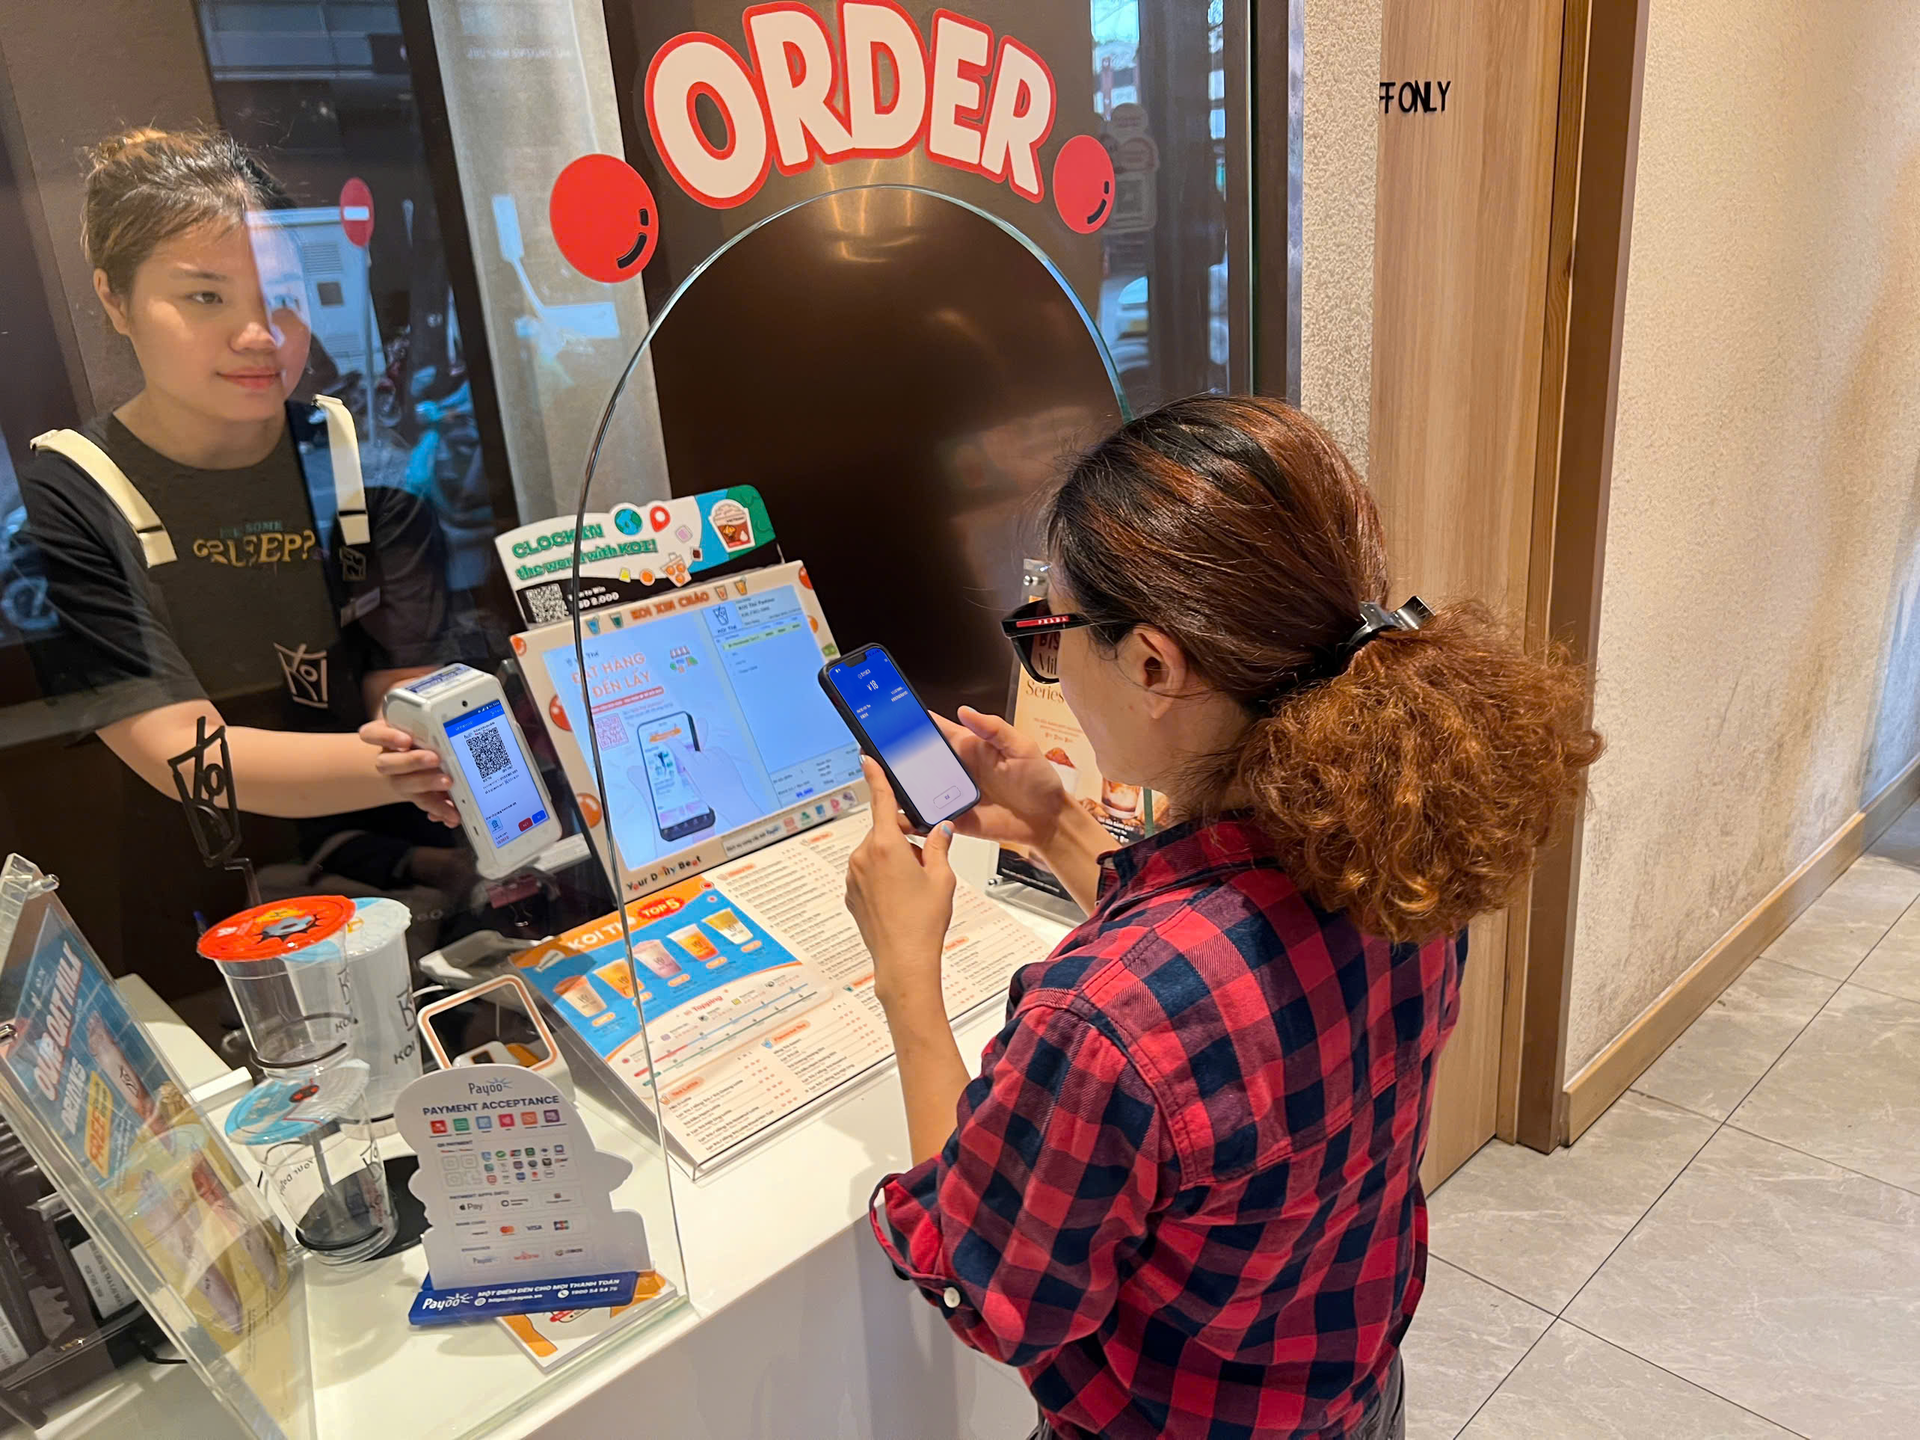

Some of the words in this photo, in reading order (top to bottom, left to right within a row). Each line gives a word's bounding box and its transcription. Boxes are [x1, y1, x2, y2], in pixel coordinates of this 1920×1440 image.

[645, 0, 1056, 209] ORDER
[1398, 80, 1451, 113] ONLY
[543, 553, 585, 573] word
[1038, 616, 1067, 625] PRADA
[1026, 680, 1064, 703] Series
[568, 930, 605, 951] KOI
[641, 904, 667, 917] TOP
[665, 898, 680, 910] 5
[692, 994, 724, 1012] Topping
[393, 1040, 415, 1065] KOI
[468, 1080, 503, 1096] Payoo
[422, 1102, 479, 1116] PAYMENT
[480, 1095, 560, 1111] ACCEPTANCE
[467, 1202, 484, 1211] Pay
[422, 1298, 460, 1311] Payoo
